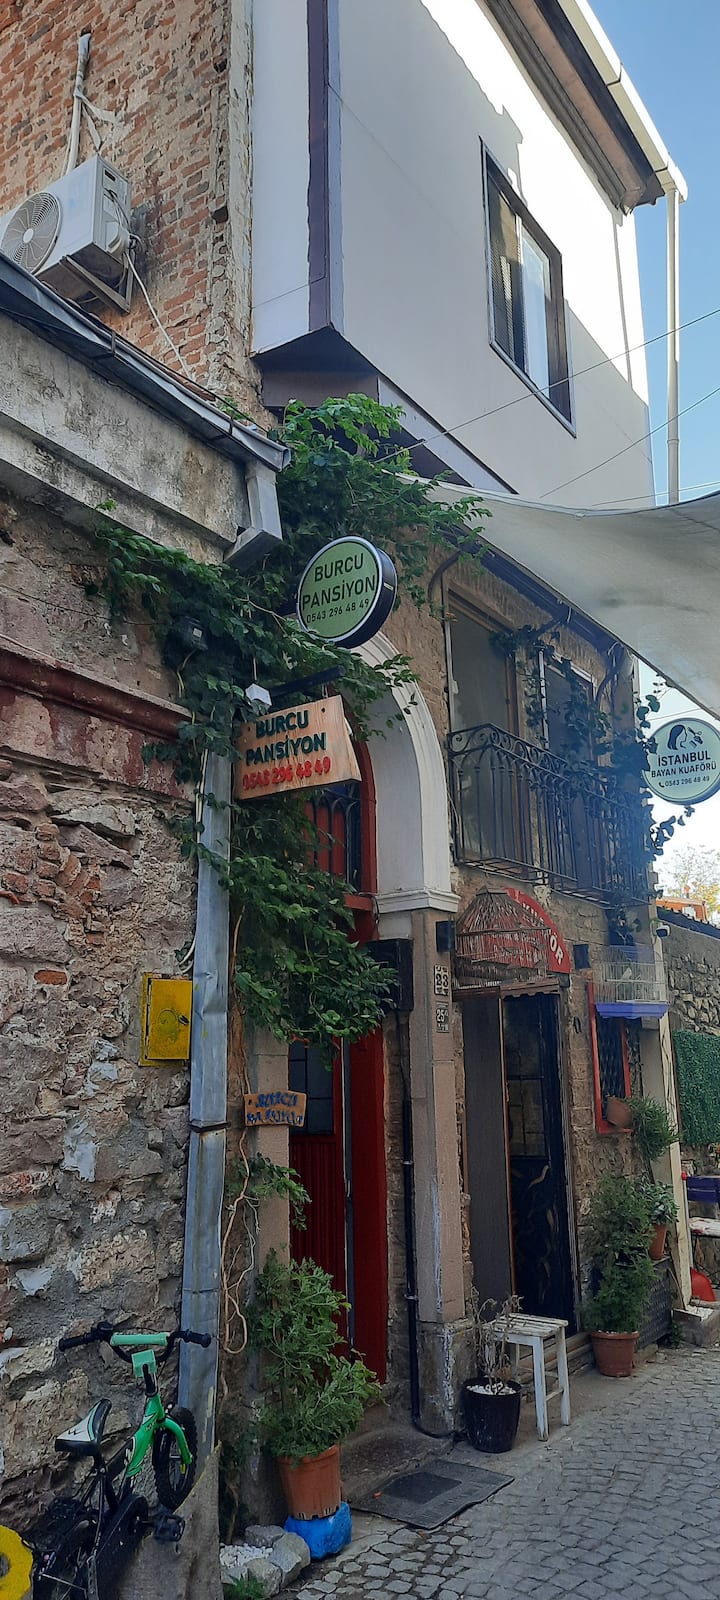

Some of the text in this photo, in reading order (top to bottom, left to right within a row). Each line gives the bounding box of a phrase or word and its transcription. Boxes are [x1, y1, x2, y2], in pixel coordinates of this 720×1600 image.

[314, 552, 364, 583] BURCU
[302, 575, 376, 611] PANSİYON
[306, 598, 369, 624] 0543 296 48 49
[255, 709, 310, 739] BURCU
[245, 731, 327, 766] PANSİYON
[657, 750, 711, 767] İSTANBUL
[271, 764, 294, 785] 296
[295, 760, 312, 778] 48
[651, 760, 717, 778] BAYAN KUAFÖRÜ
[664, 778, 680, 787] 0543
